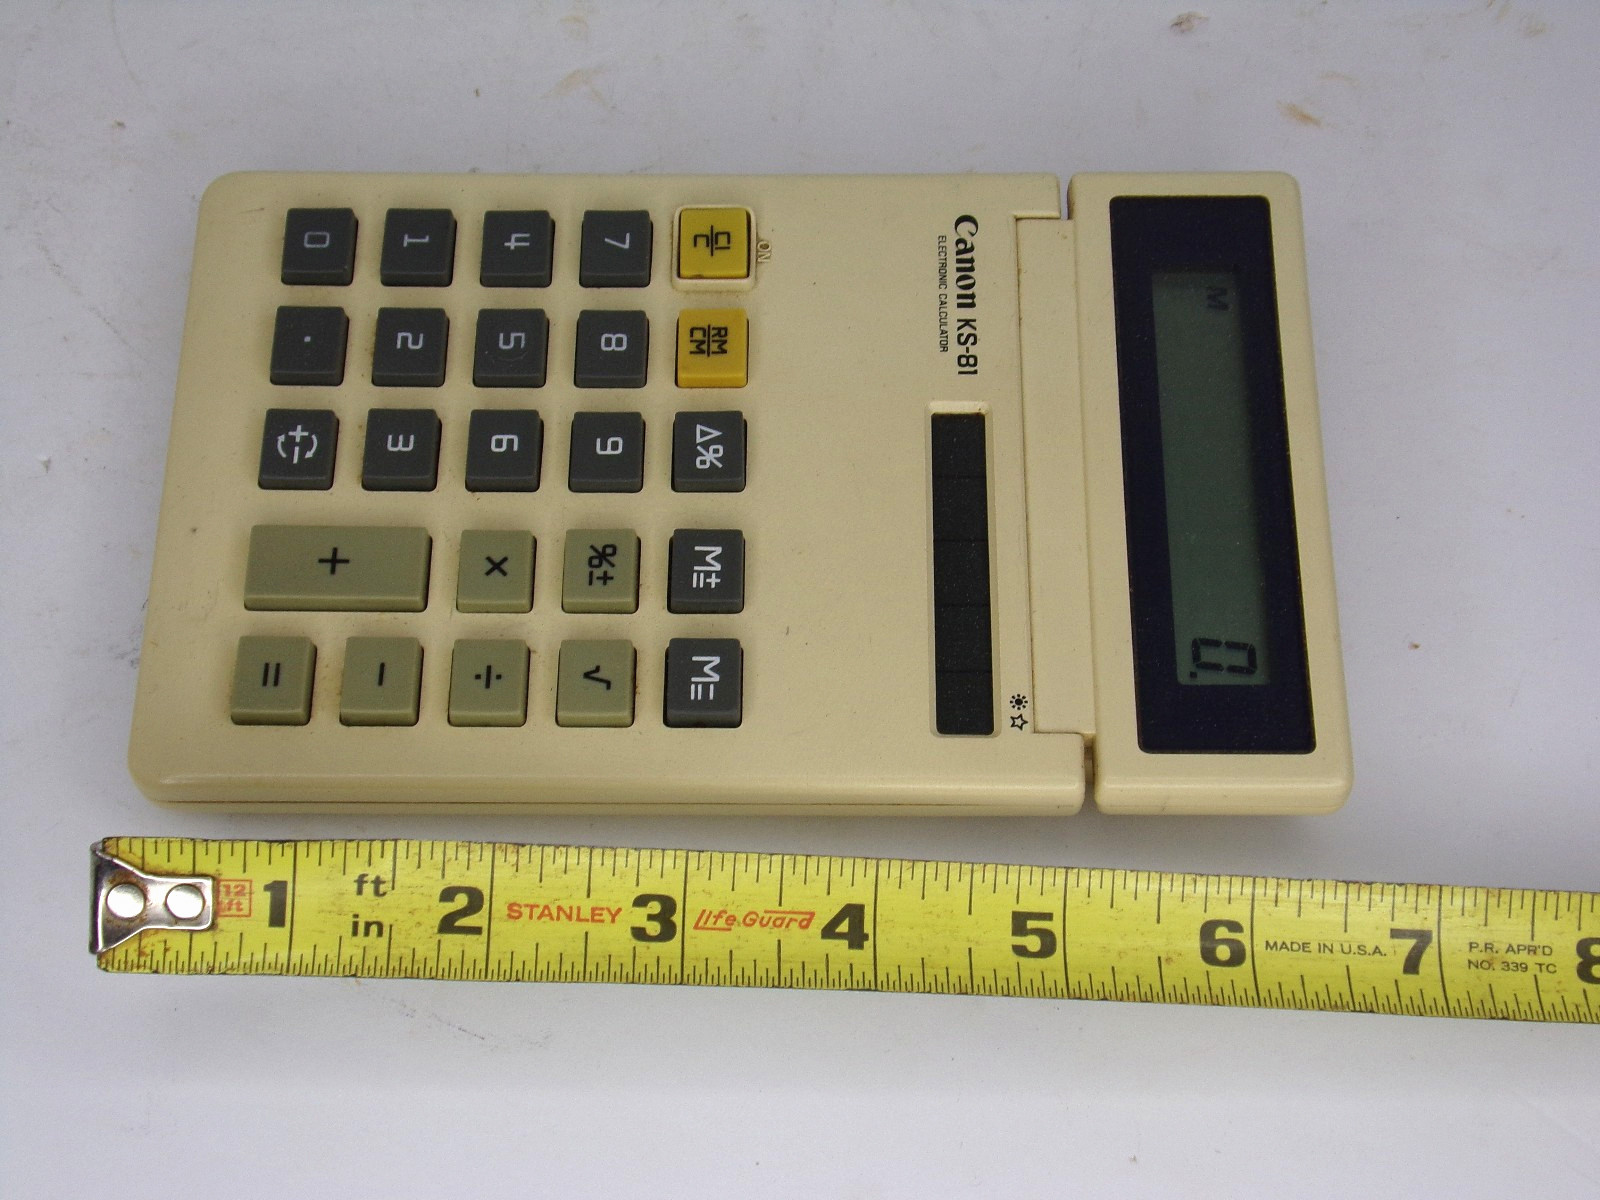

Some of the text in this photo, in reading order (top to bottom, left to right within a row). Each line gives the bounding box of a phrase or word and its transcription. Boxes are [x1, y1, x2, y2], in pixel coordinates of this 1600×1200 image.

[403, 233, 429, 247] 1
[504, 232, 530, 250] 4
[604, 232, 630, 249] 7
[757, 240, 772, 263] ON
[938, 235, 949, 353] ELECTRONIC CALCULATOR
[954, 214, 979, 375] Canon KS-81
[396, 331, 423, 350] 2
[499, 332, 525, 350] 5
[600, 333, 627, 351] 8
[689, 326, 706, 355] CM
[711, 326, 728, 354] RM
[387, 434, 414, 452] 3
[490, 434, 518, 452] 6
[596, 436, 623, 455] 9
[222, 884, 246, 897] 12
[354, 873, 387, 897] ft
[225, 900, 243, 912] ft
[263, 880, 288, 928] 1
[437, 886, 485, 935] 2
[506, 901, 623, 925] STANLEY
[352, 914, 384, 938] in
[630, 893, 678, 943] 3
[820, 903, 869, 950] 4
[1010, 911, 1058, 959] 5
[1200, 919, 1246, 967] 6
[1265, 940, 1387, 957] MADE IN U.S.A.
[1390, 928, 1433, 975] 7
[1469, 942, 1553, 956] P.R. APR'D
[1467, 959, 1557, 974] NO. 339 TC
